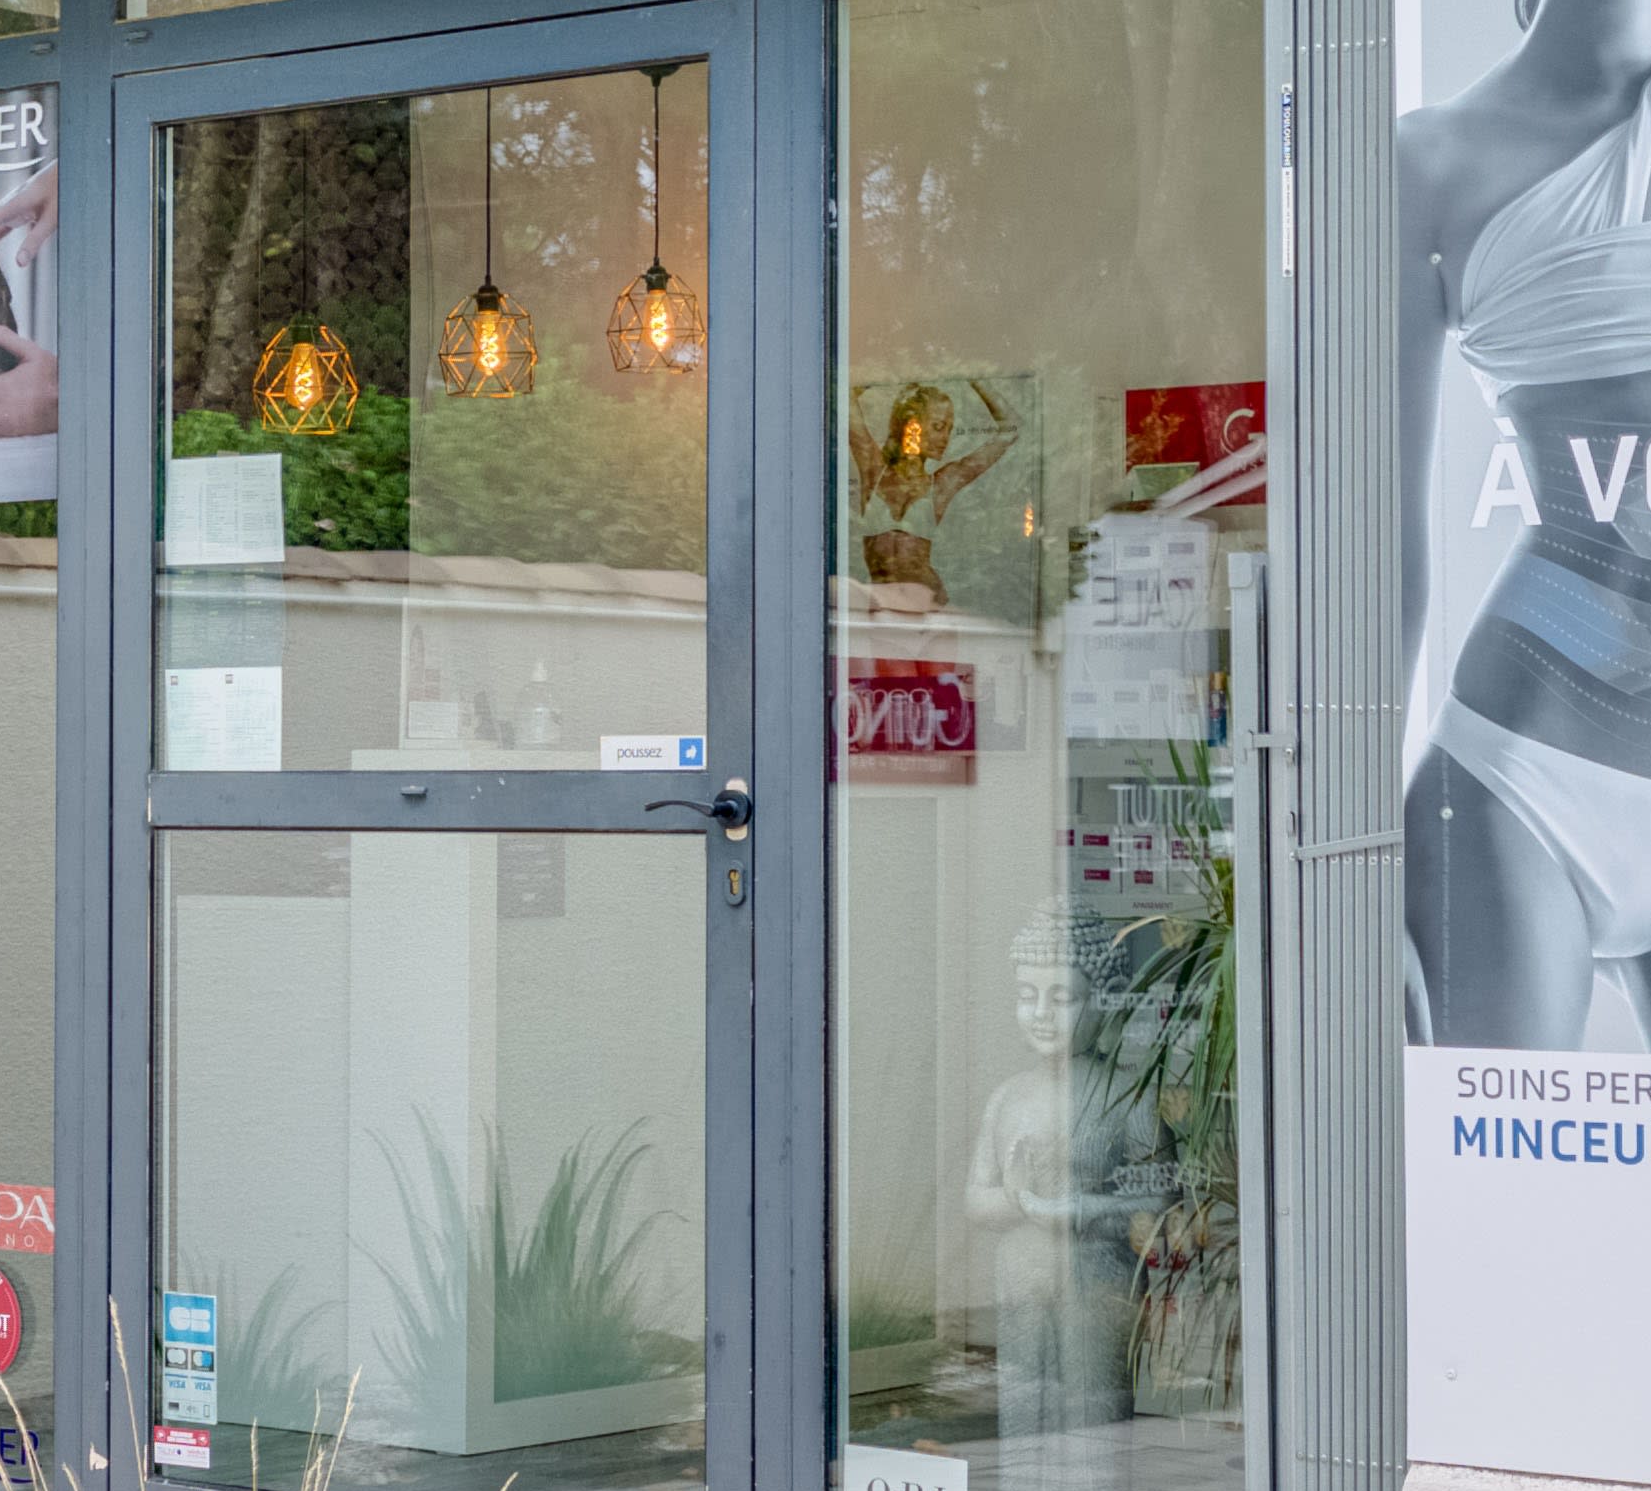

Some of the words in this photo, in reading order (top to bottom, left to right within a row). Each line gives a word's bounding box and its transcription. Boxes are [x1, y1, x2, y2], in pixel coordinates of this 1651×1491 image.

[1469, 417, 1543, 530] À
[617, 747, 663, 764] poussez
[1457, 1066, 1571, 1102] SOINS
[168, 1379, 186, 1389] VISA
[194, 1381, 212, 1391] VISA
